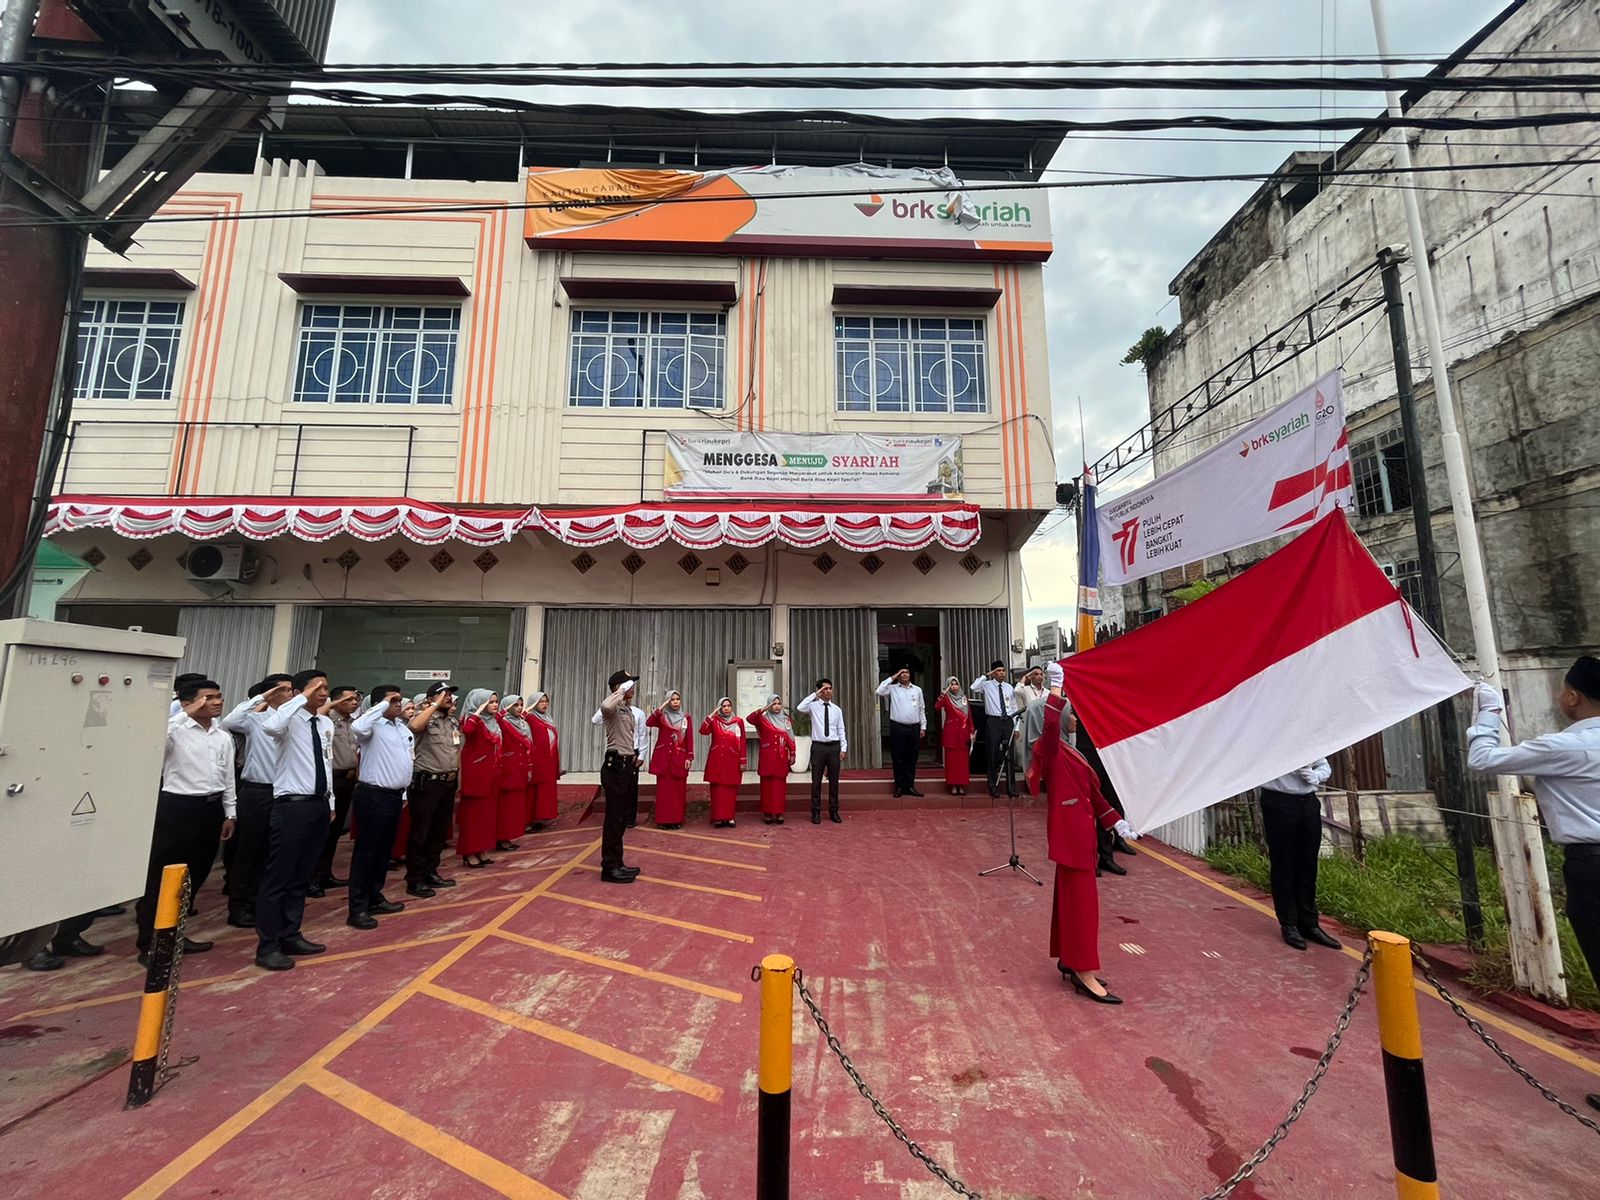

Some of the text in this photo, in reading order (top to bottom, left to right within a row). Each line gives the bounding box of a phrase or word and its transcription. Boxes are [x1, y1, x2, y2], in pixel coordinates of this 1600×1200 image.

[592, 182, 641, 194] CABANG
[1315, 405, 1335, 420] G20
[1250, 412, 1310, 450] brksyariah
[703, 452, 900, 468] MENGGESA MENUJU SYARI'AH
[1129, 495, 1154, 513] INDONESIA
[1142, 513, 1162, 528] PULIH
[1143, 514, 1184, 539] LEBIH CEPAT
[1112, 516, 1140, 575] 77
[1145, 532, 1173, 550] BANGKIT
[1146, 539, 1183, 559] LEBIH KUAT
